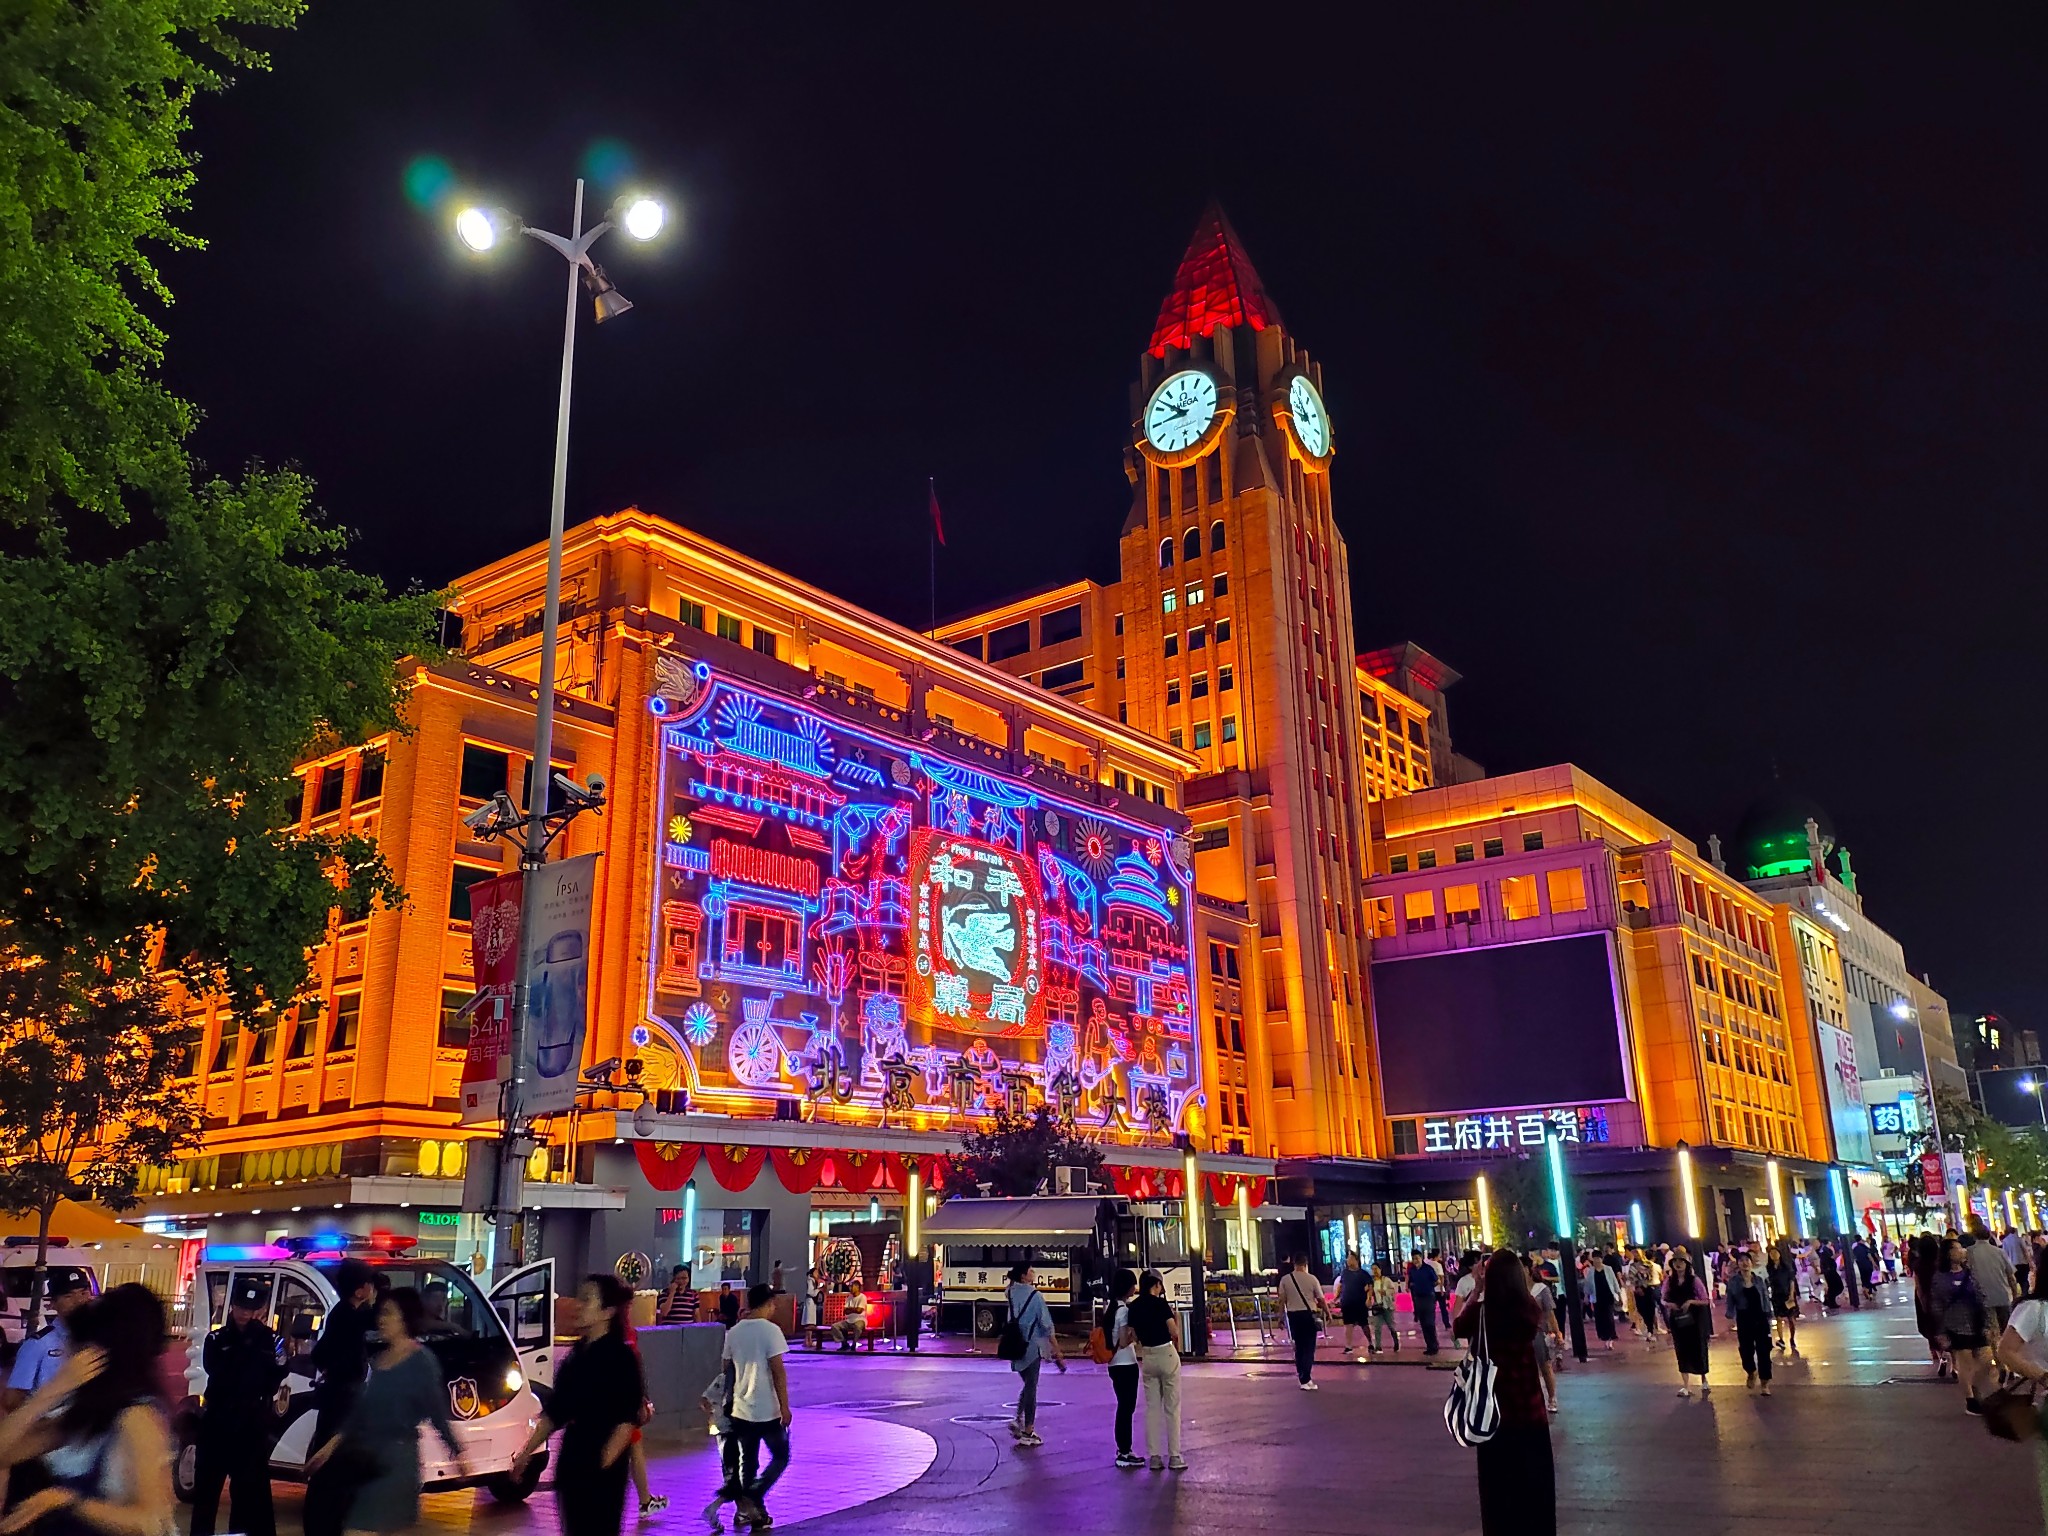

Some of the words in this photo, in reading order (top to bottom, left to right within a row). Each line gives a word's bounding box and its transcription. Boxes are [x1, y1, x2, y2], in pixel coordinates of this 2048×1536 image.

[929, 854, 1026, 907] 和平
[809, 1046, 1171, 1137] 北京市百货大楼
[1424, 1111, 1579, 1152] 王府井百货
[1874, 1106, 1900, 1131] 药
[957, 1271, 988, 1284] 警察
[1001, 1275, 1054, 1286] PCE
